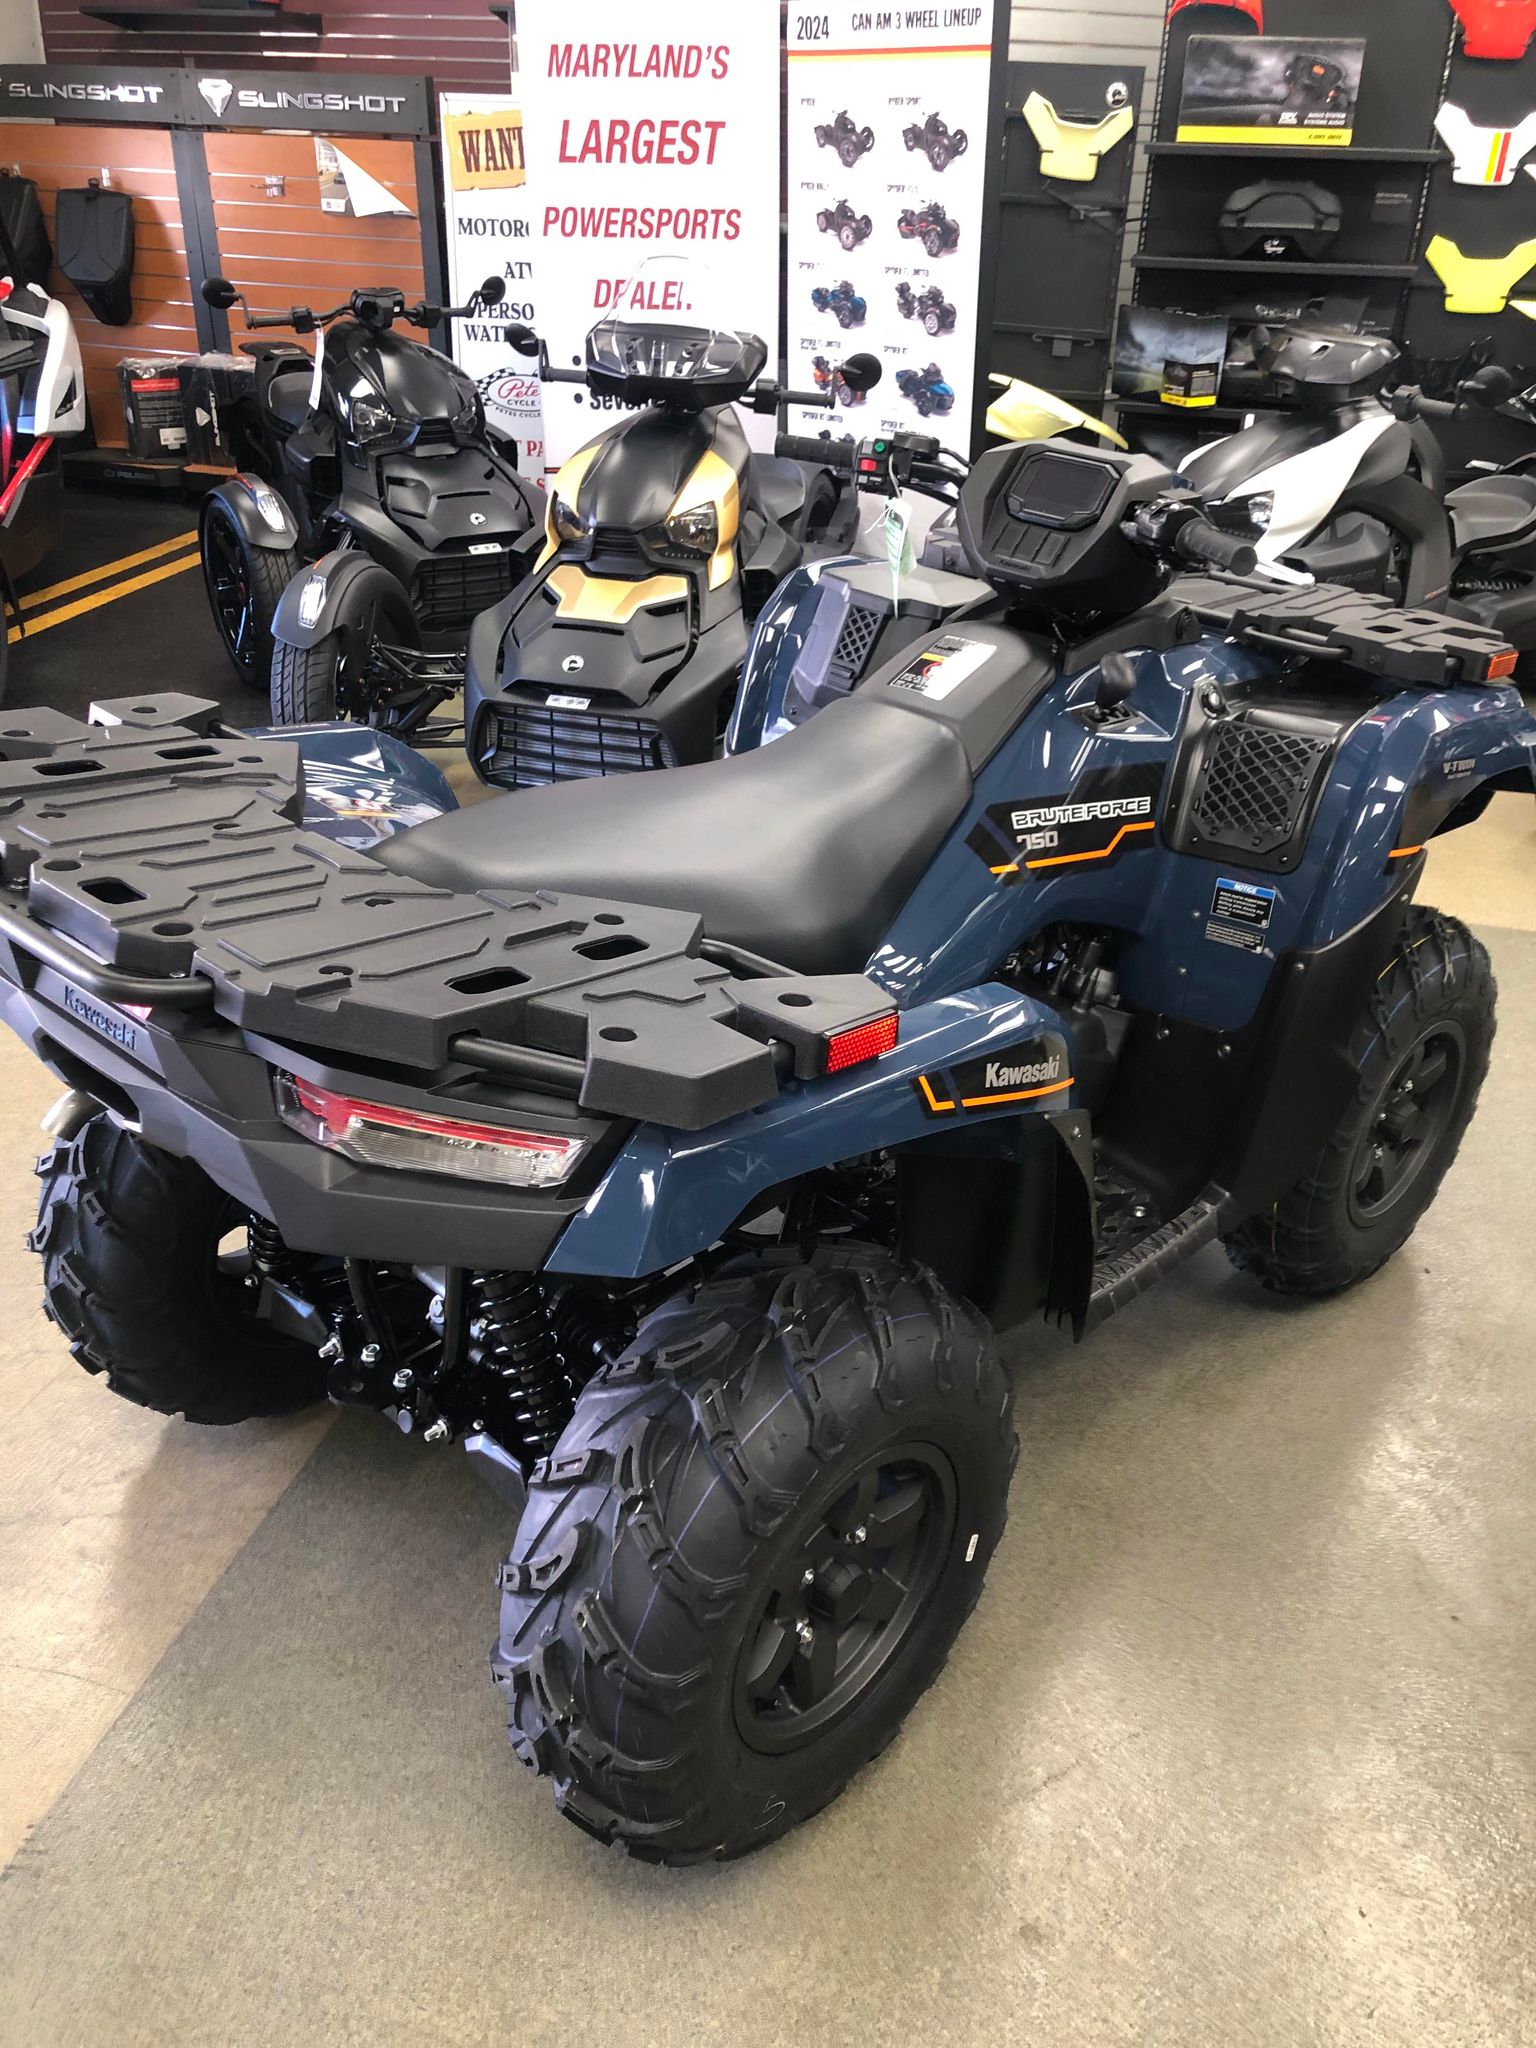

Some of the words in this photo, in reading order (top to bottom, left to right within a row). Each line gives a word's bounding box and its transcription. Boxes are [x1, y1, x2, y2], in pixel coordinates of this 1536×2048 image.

[797, 15, 829, 40] 2024
[851, 13, 872, 31] CAN
[876, 12, 892, 30] AM
[895, 11, 901, 29] 3
[905, 10, 939, 28] WHEEL
[943, 7, 982, 27] LINEUP
[547, 43, 730, 79] MARYLAND'S
[8, 83, 164, 103] SLINGSHOT
[237, 90, 406, 113] SLINGSHOT
[558, 119, 726, 165] LARGEST
[543, 206, 742, 240] POWERSPORTS
[507, 399, 536, 407] CYCLE
[1016, 830, 1059, 850] 750
[64, 984, 137, 1051] Kawasaki
[985, 1054, 1060, 1089] Kawasaki
